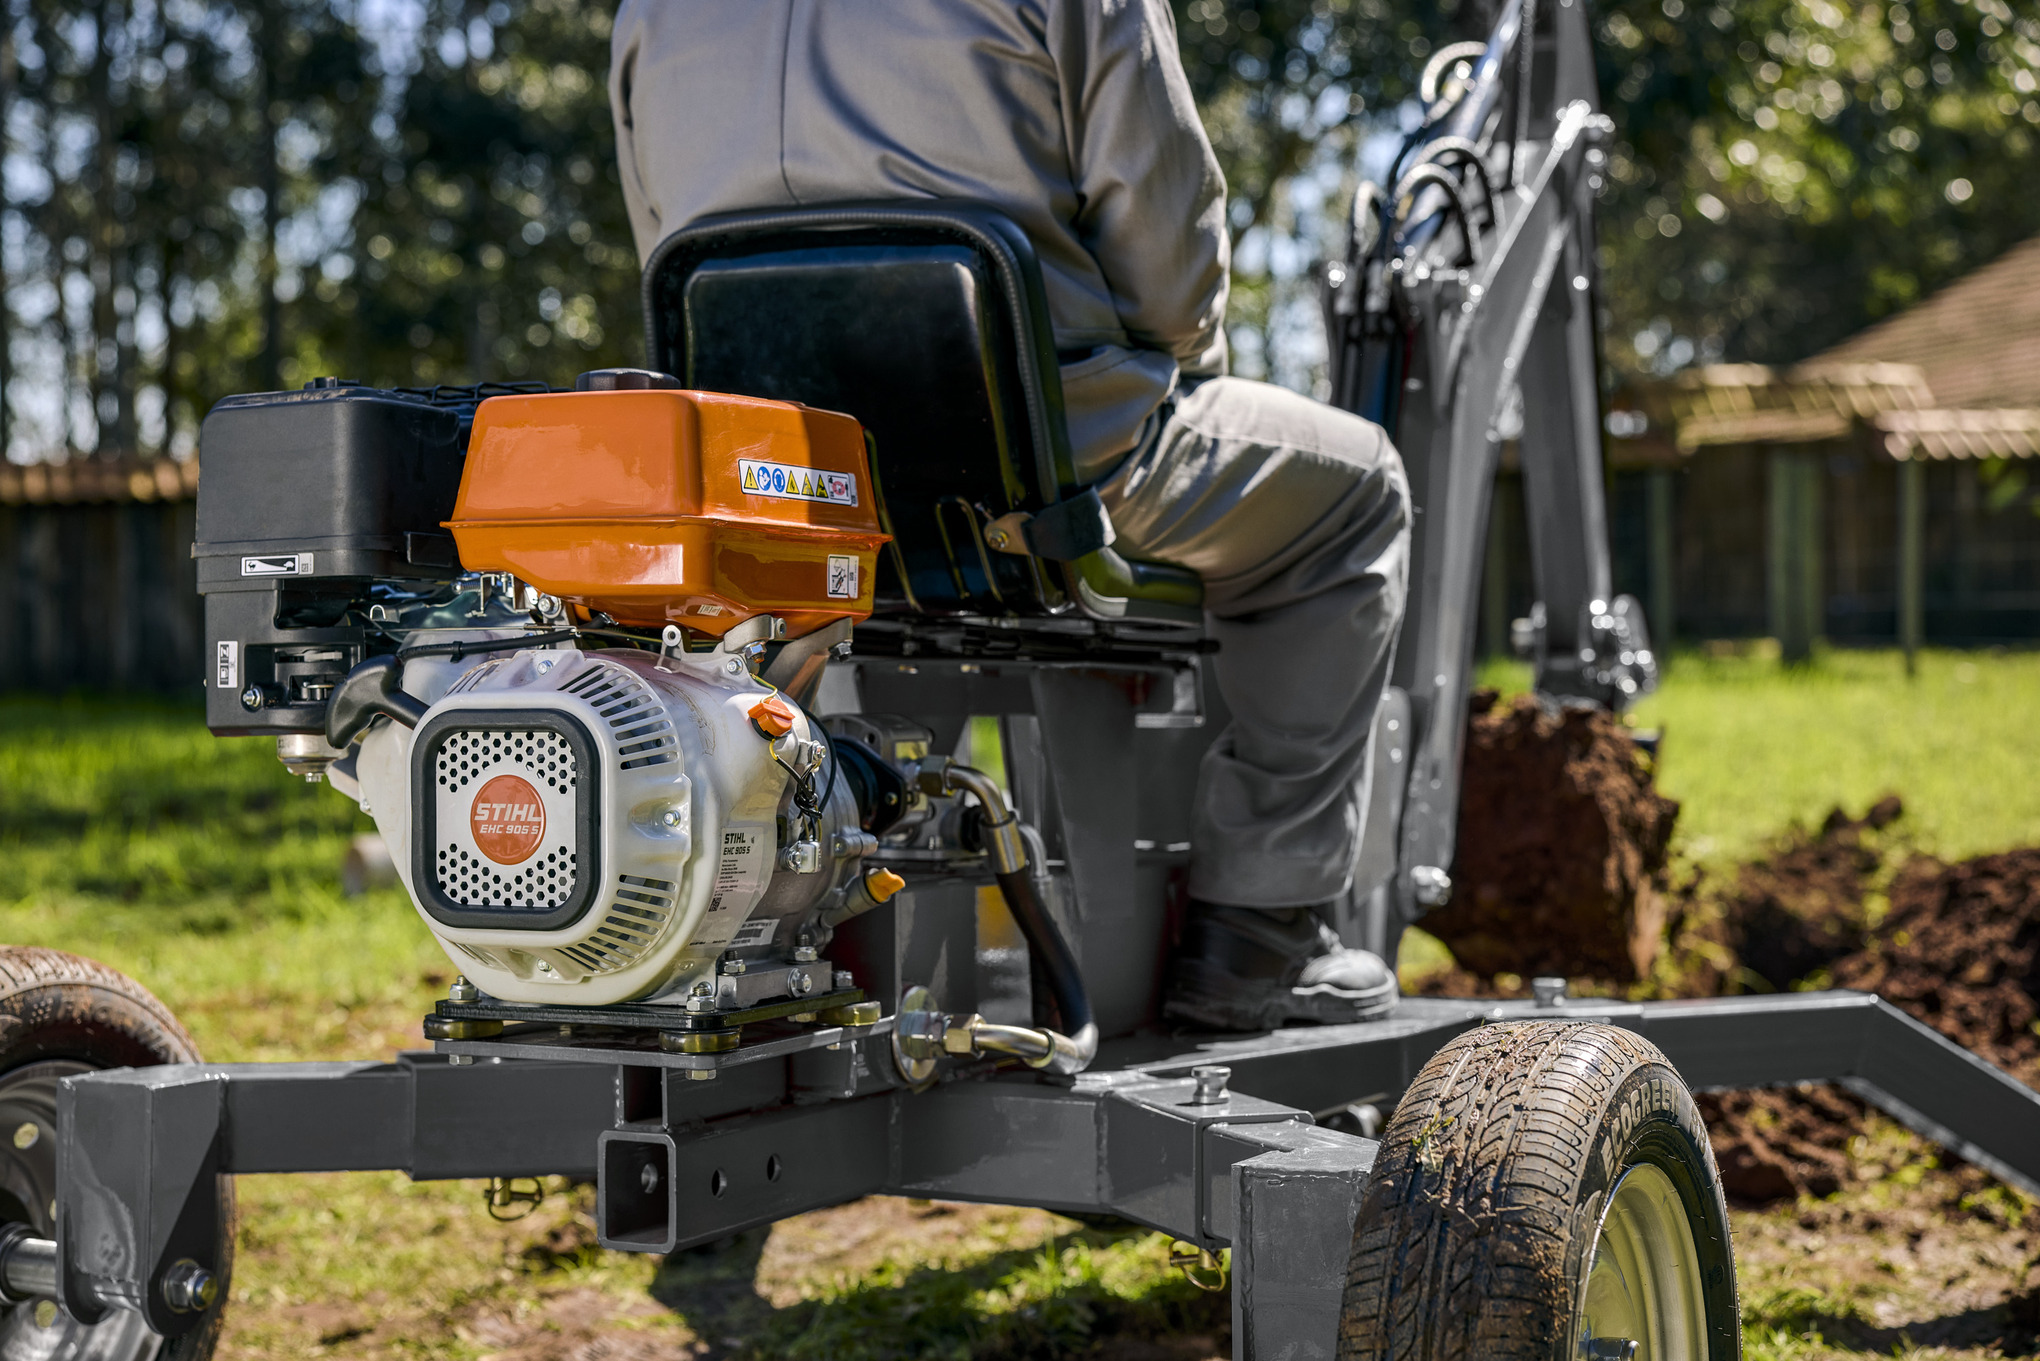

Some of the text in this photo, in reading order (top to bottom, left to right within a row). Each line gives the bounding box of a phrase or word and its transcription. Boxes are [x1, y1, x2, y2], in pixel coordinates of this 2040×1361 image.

[474, 803, 542, 822] STIHL
[479, 824, 540, 835] EHC 905 S
[724, 832, 746, 844] STIHL
[723, 846, 735, 855] EHC
[1601, 1078, 1681, 1183] ECOGREEN
